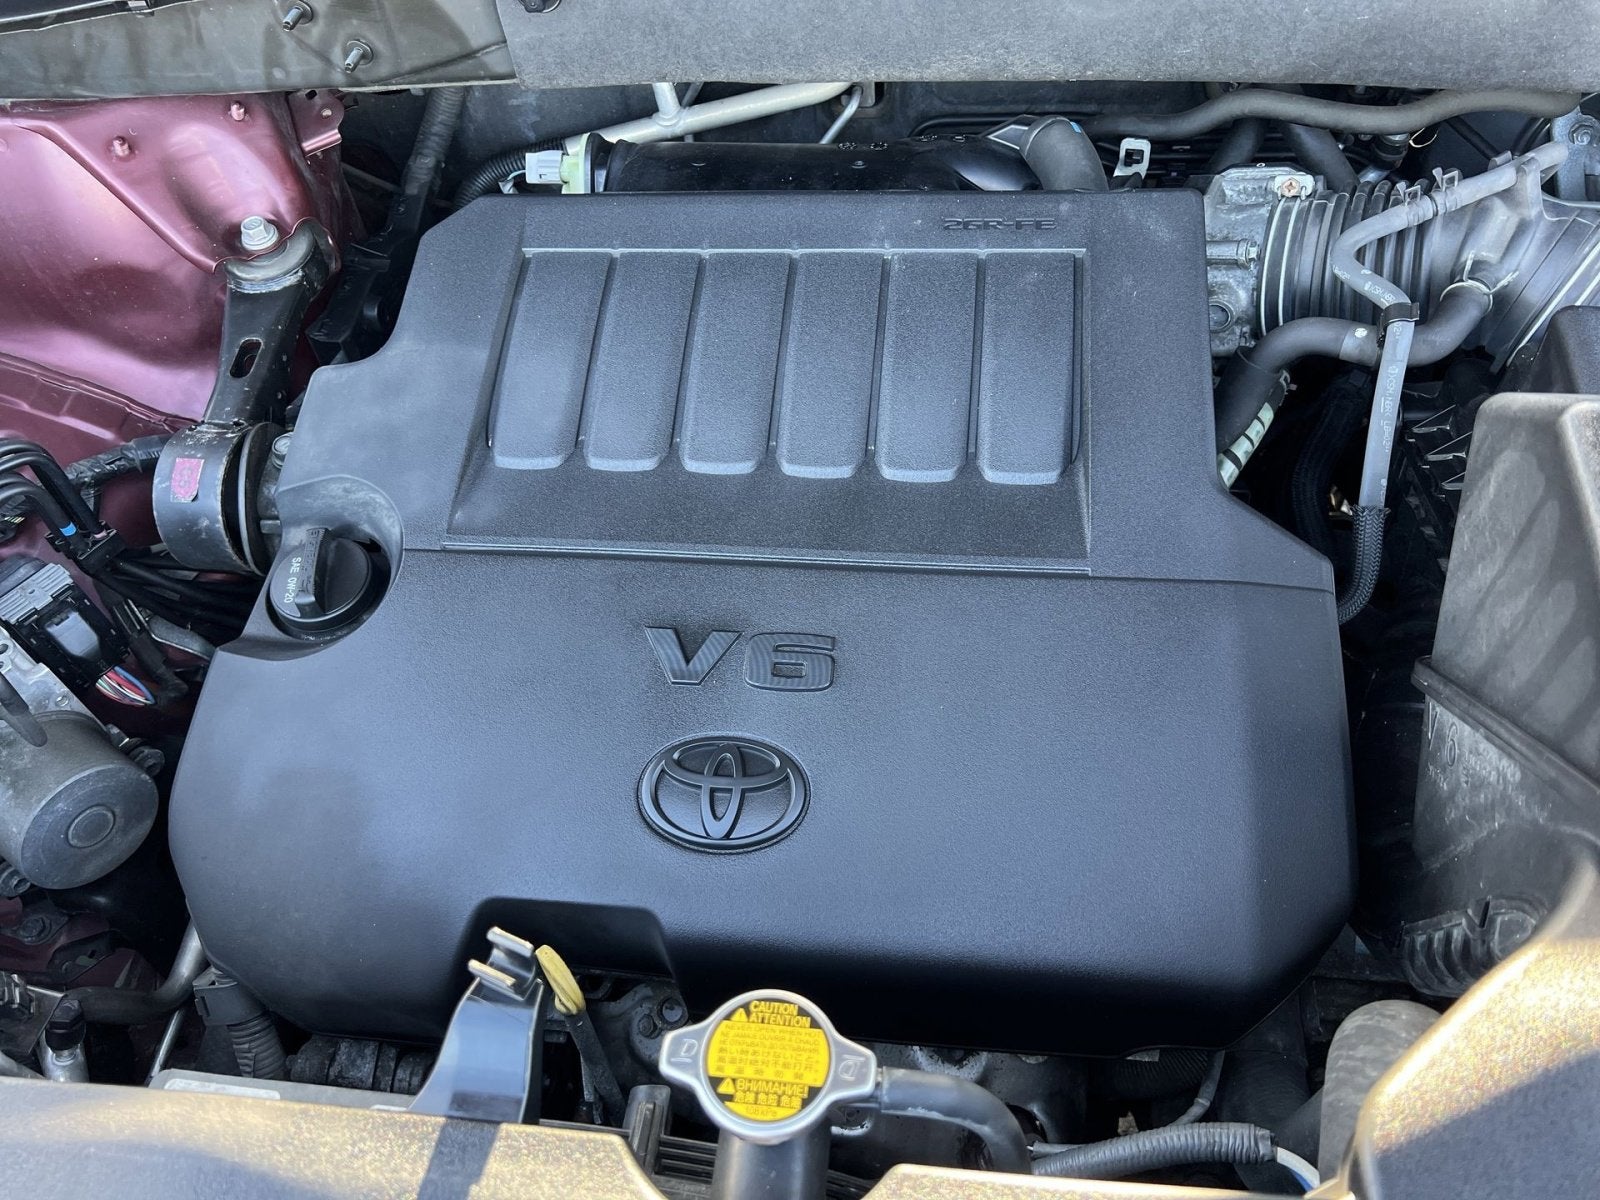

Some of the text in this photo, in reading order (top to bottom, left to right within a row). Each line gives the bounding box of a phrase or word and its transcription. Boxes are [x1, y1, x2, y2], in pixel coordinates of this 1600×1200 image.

[284, 557, 301, 603] SAE 0W-20
[644, 625, 836, 692] V6
[750, 1001, 798, 1016] CAUTION
[749, 1013, 811, 1028] ATTENTION
[736, 1078, 809, 1098] ВНИМАНИЕ!
